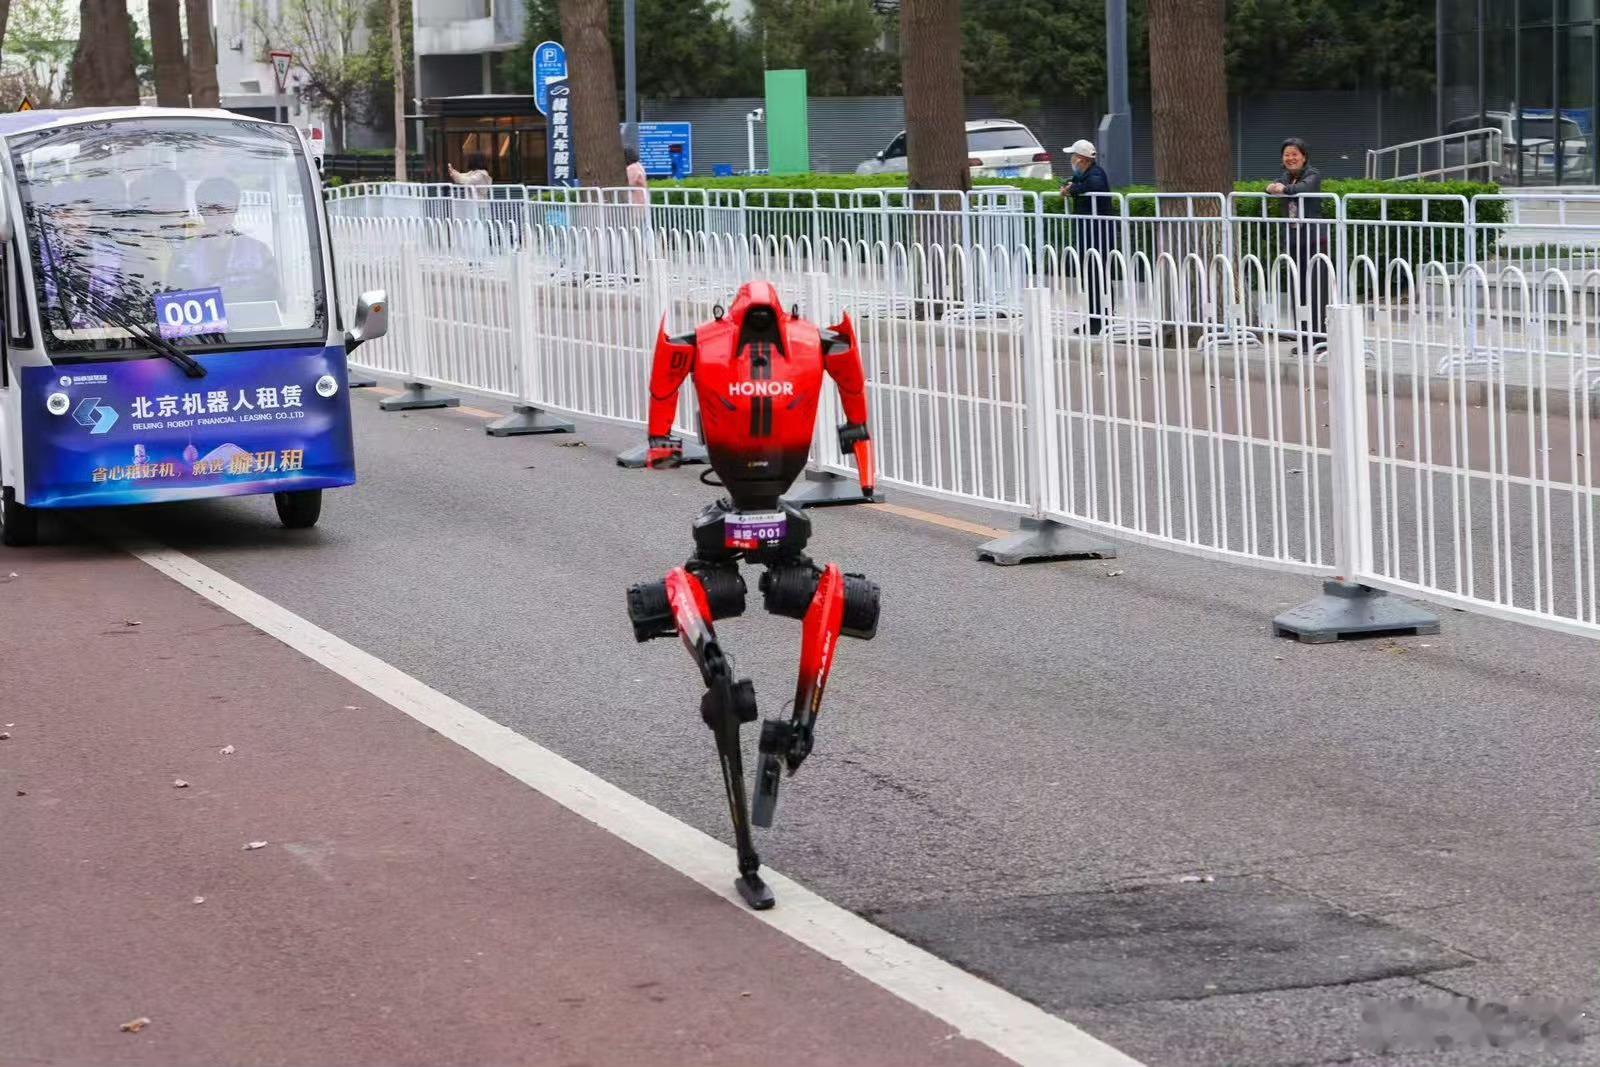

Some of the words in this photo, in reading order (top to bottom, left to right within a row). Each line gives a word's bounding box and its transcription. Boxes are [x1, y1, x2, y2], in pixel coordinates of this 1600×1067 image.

[165, 298, 220, 326] 001
[728, 380, 794, 396] HONOR
[131, 384, 304, 419] 北京机器人租赁
[132, 422, 164, 431] BEIJING
[167, 419, 194, 429] ROBOT
[197, 415, 237, 426] FINANCIAL
[240, 412, 273, 423] LEASING
